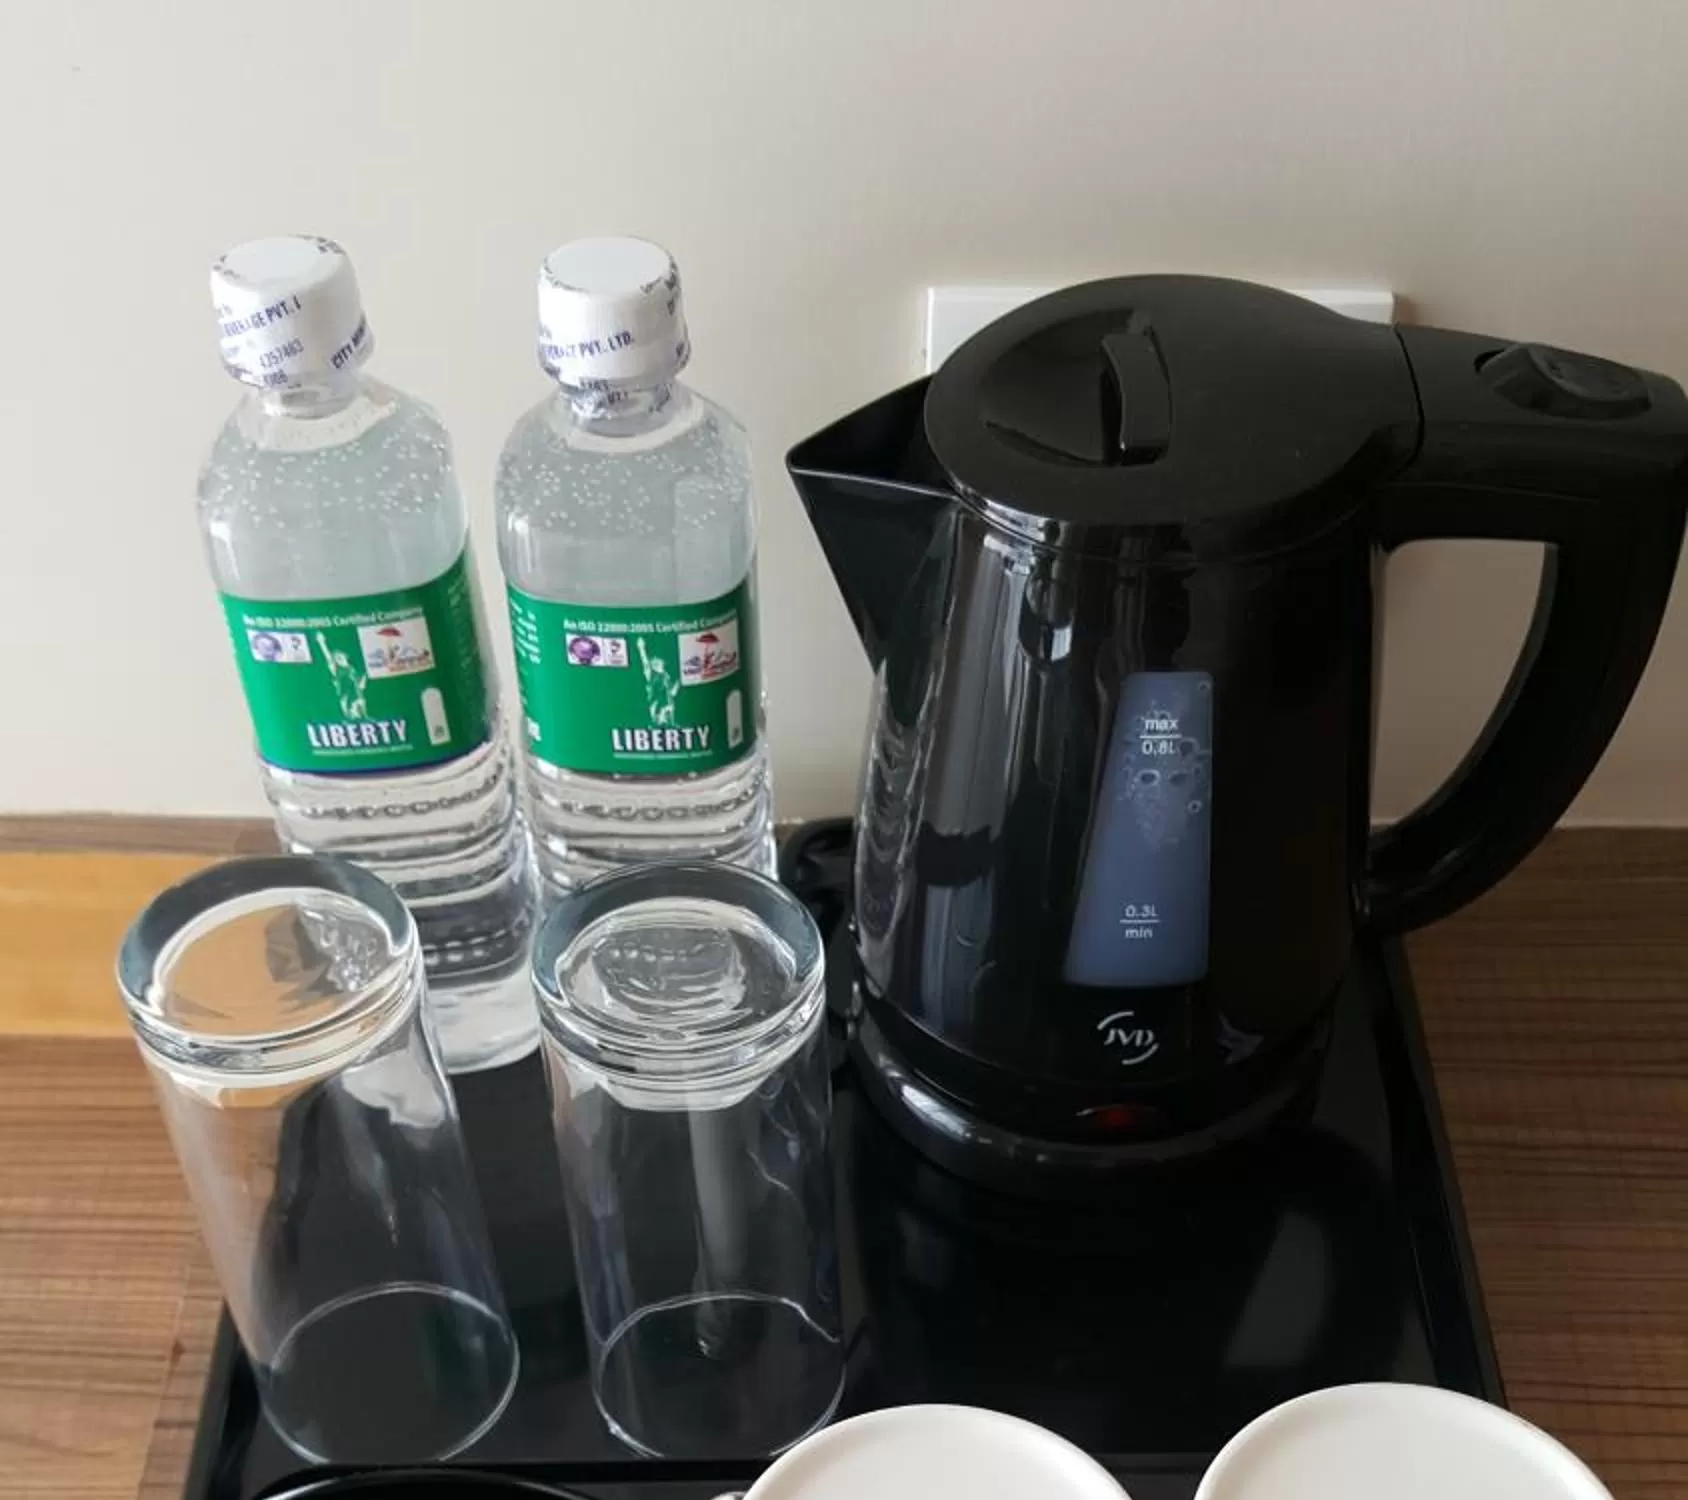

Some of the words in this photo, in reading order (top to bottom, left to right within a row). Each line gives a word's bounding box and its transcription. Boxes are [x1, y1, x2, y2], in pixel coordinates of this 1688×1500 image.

[306, 719, 407, 748] LIBERTY
[1144, 719, 1179, 731] max
[611, 725, 710, 752] LIBERTY
[1125, 926, 1154, 939] min
